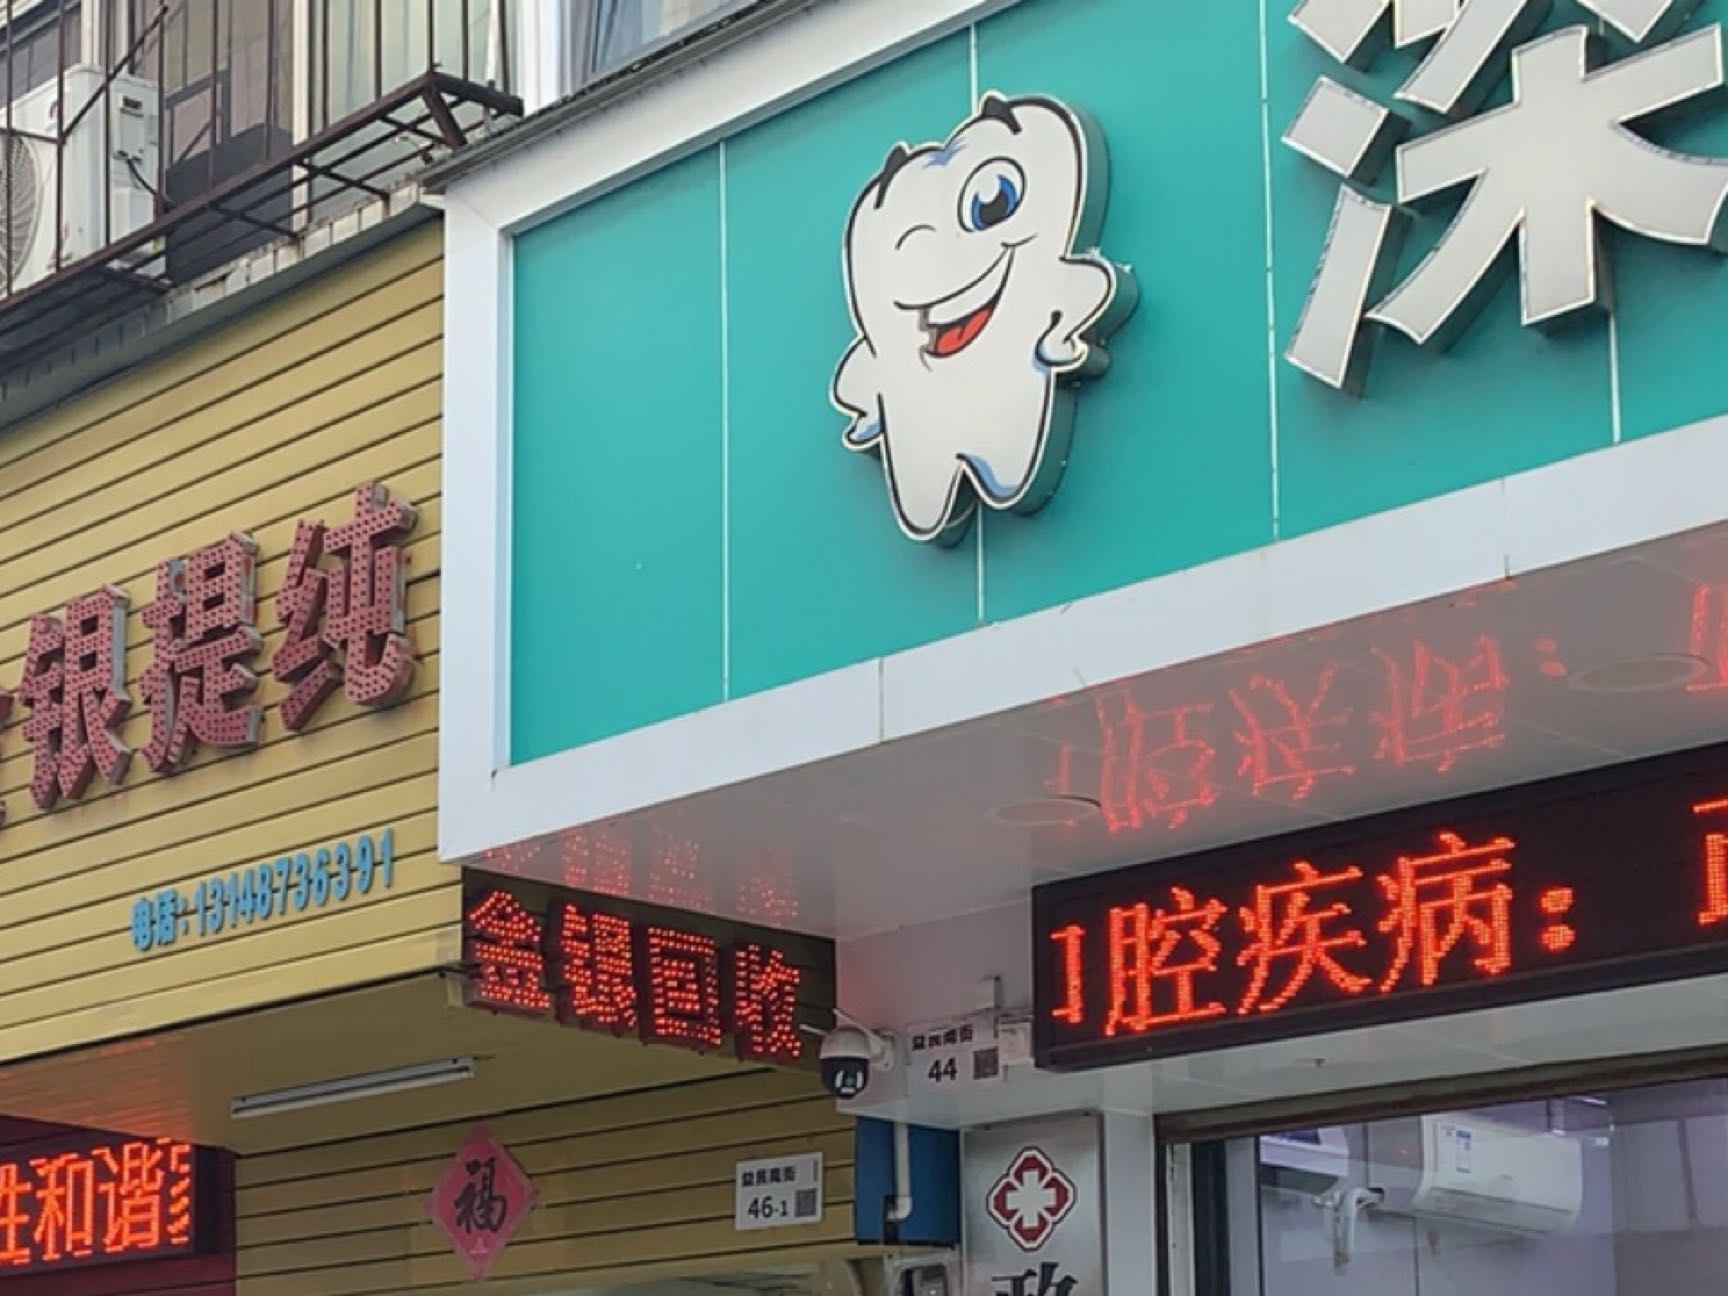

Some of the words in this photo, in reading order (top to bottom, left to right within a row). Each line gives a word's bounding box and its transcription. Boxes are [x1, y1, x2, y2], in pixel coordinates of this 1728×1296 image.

[471, 889, 802, 1061] 金银回收
[928, 1057, 957, 1083] 44
[453, 1157, 508, 1234] 福
[748, 1195, 787, 1219] 46-1
